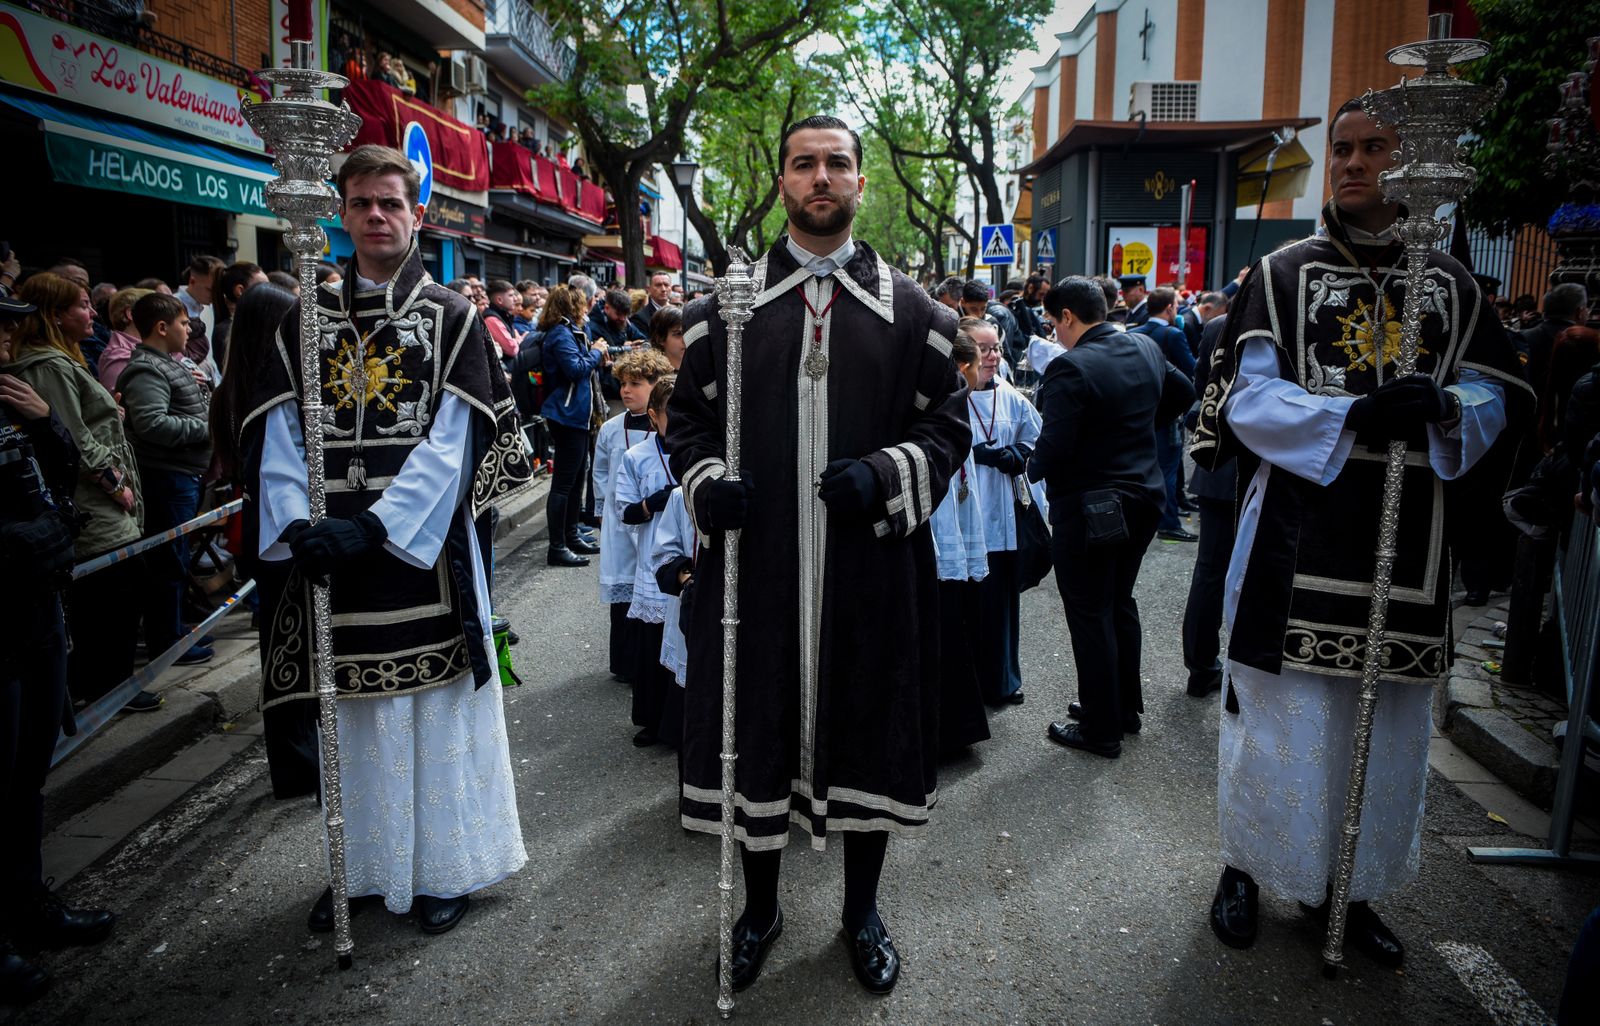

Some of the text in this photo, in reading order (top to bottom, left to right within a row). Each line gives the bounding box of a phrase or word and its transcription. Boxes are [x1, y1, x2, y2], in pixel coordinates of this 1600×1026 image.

[90, 42, 245, 128] Los Valencianos
[174, 116, 200, 131] HELADOS
[88, 150, 183, 192] HELADOS
[196, 172, 229, 200] LOS
